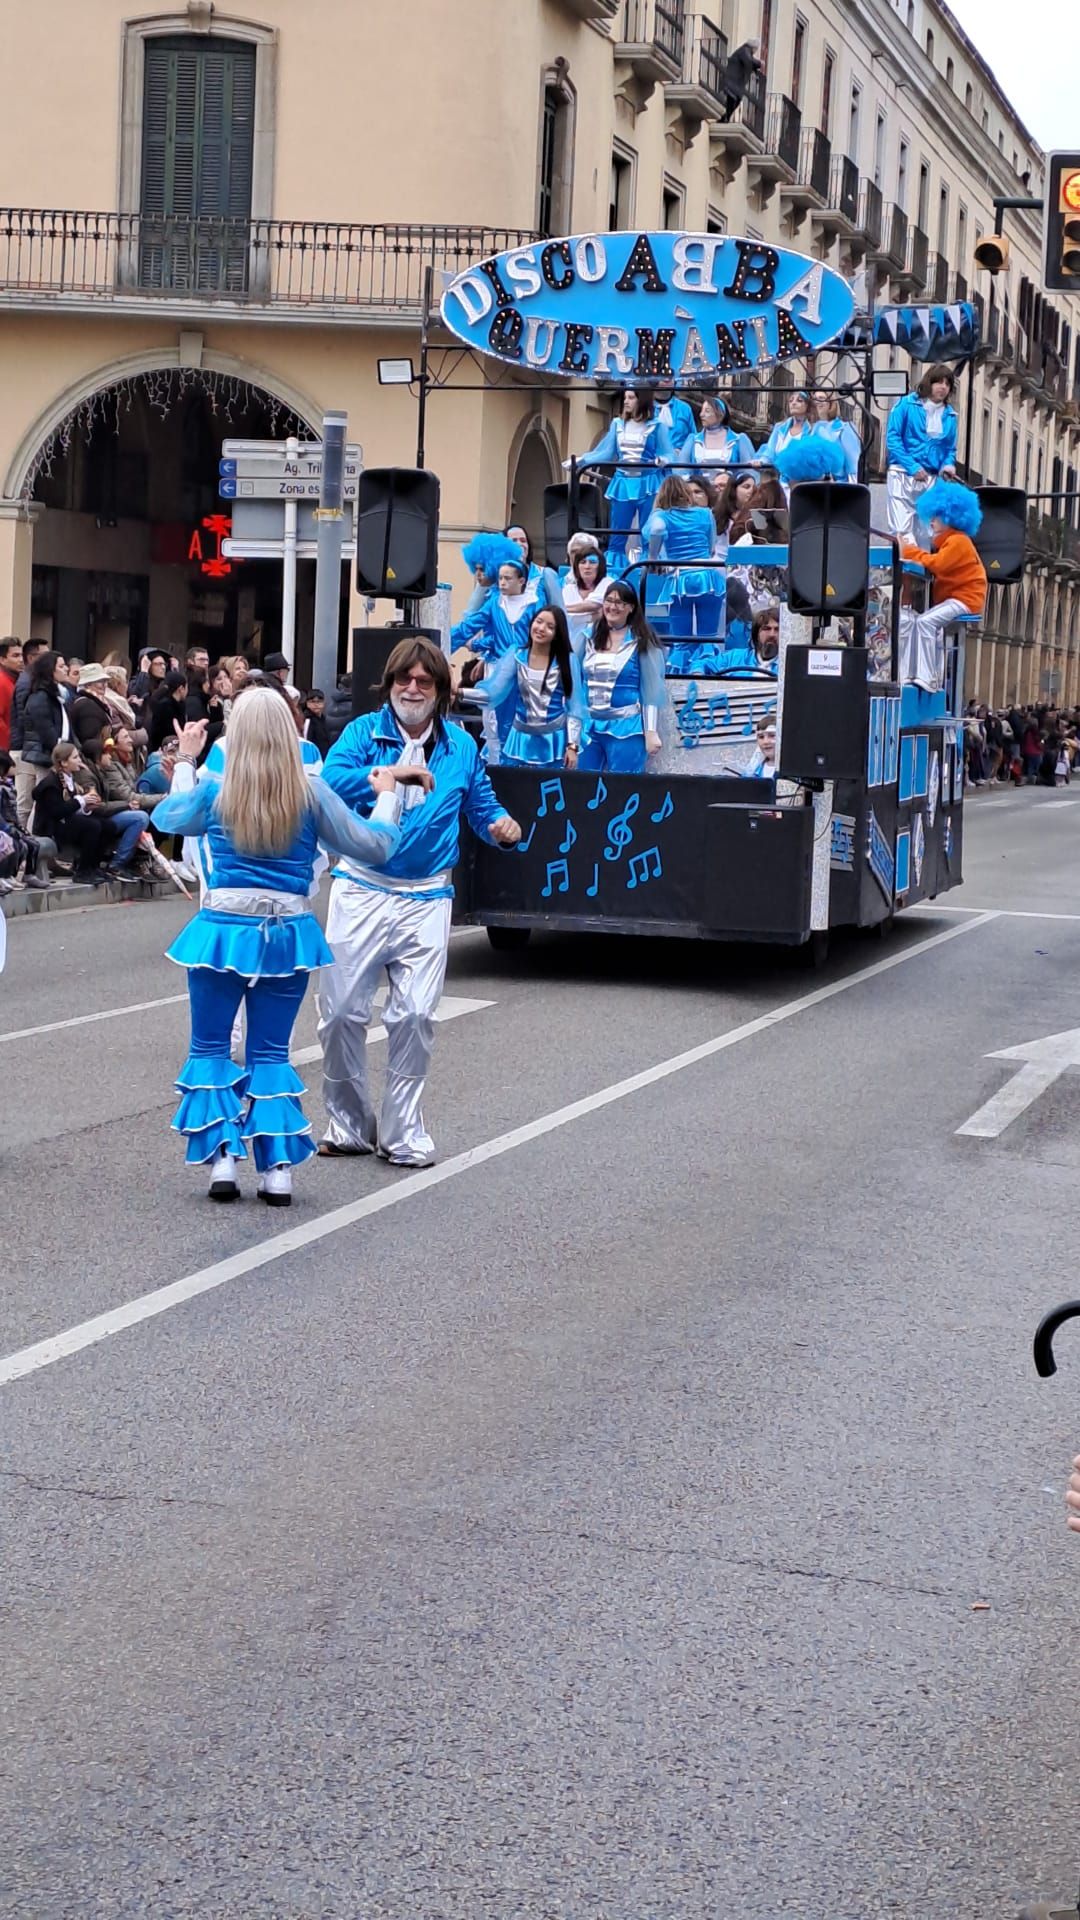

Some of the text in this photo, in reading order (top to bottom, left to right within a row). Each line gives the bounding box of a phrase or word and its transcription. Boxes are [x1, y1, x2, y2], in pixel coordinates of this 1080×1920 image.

[450, 234, 825, 326] DISCO ABBA
[488, 304, 812, 378] QUERMÀNIA
[279, 482, 305, 494] Zona
[284, 462, 300, 476] Ag.
